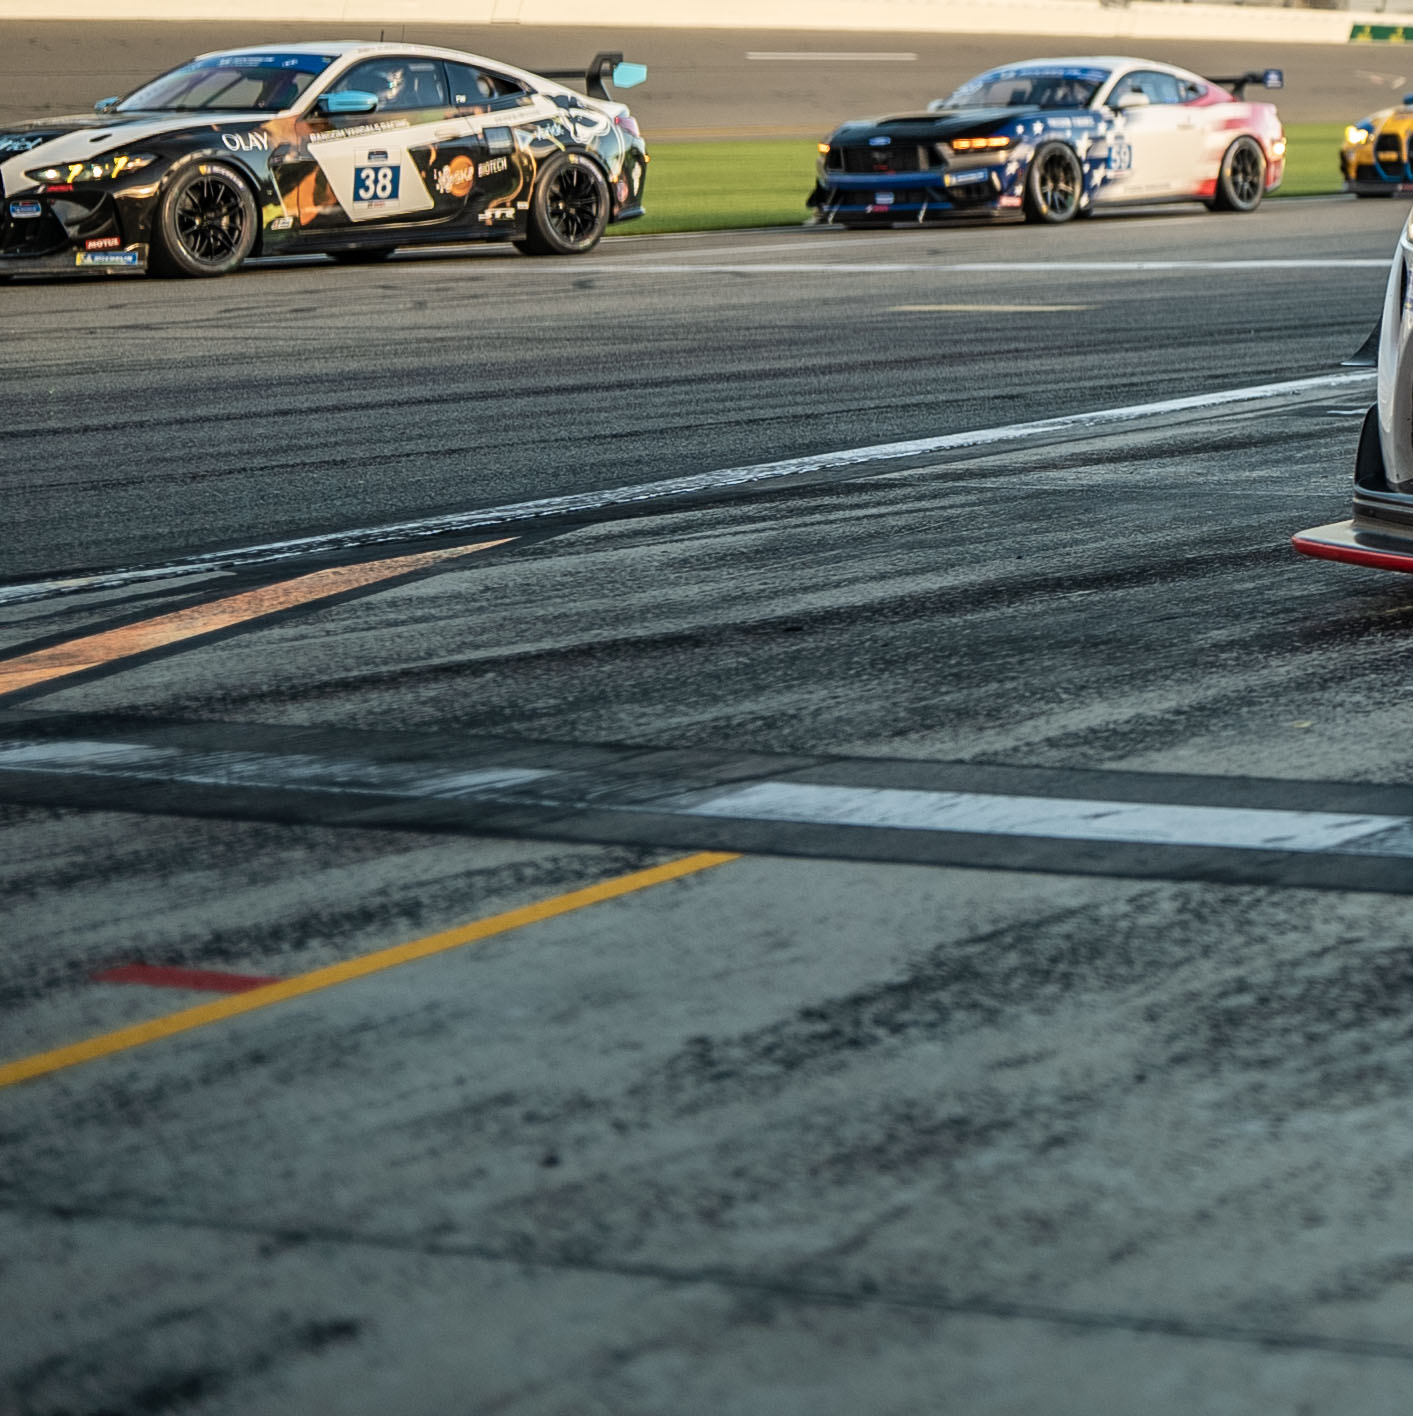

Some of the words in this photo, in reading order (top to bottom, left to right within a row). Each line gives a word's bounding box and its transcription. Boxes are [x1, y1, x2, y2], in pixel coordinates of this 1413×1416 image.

[221, 131, 269, 152] OLAY
[358, 167, 393, 200] 38
[87, 237, 120, 249] MOTUL
